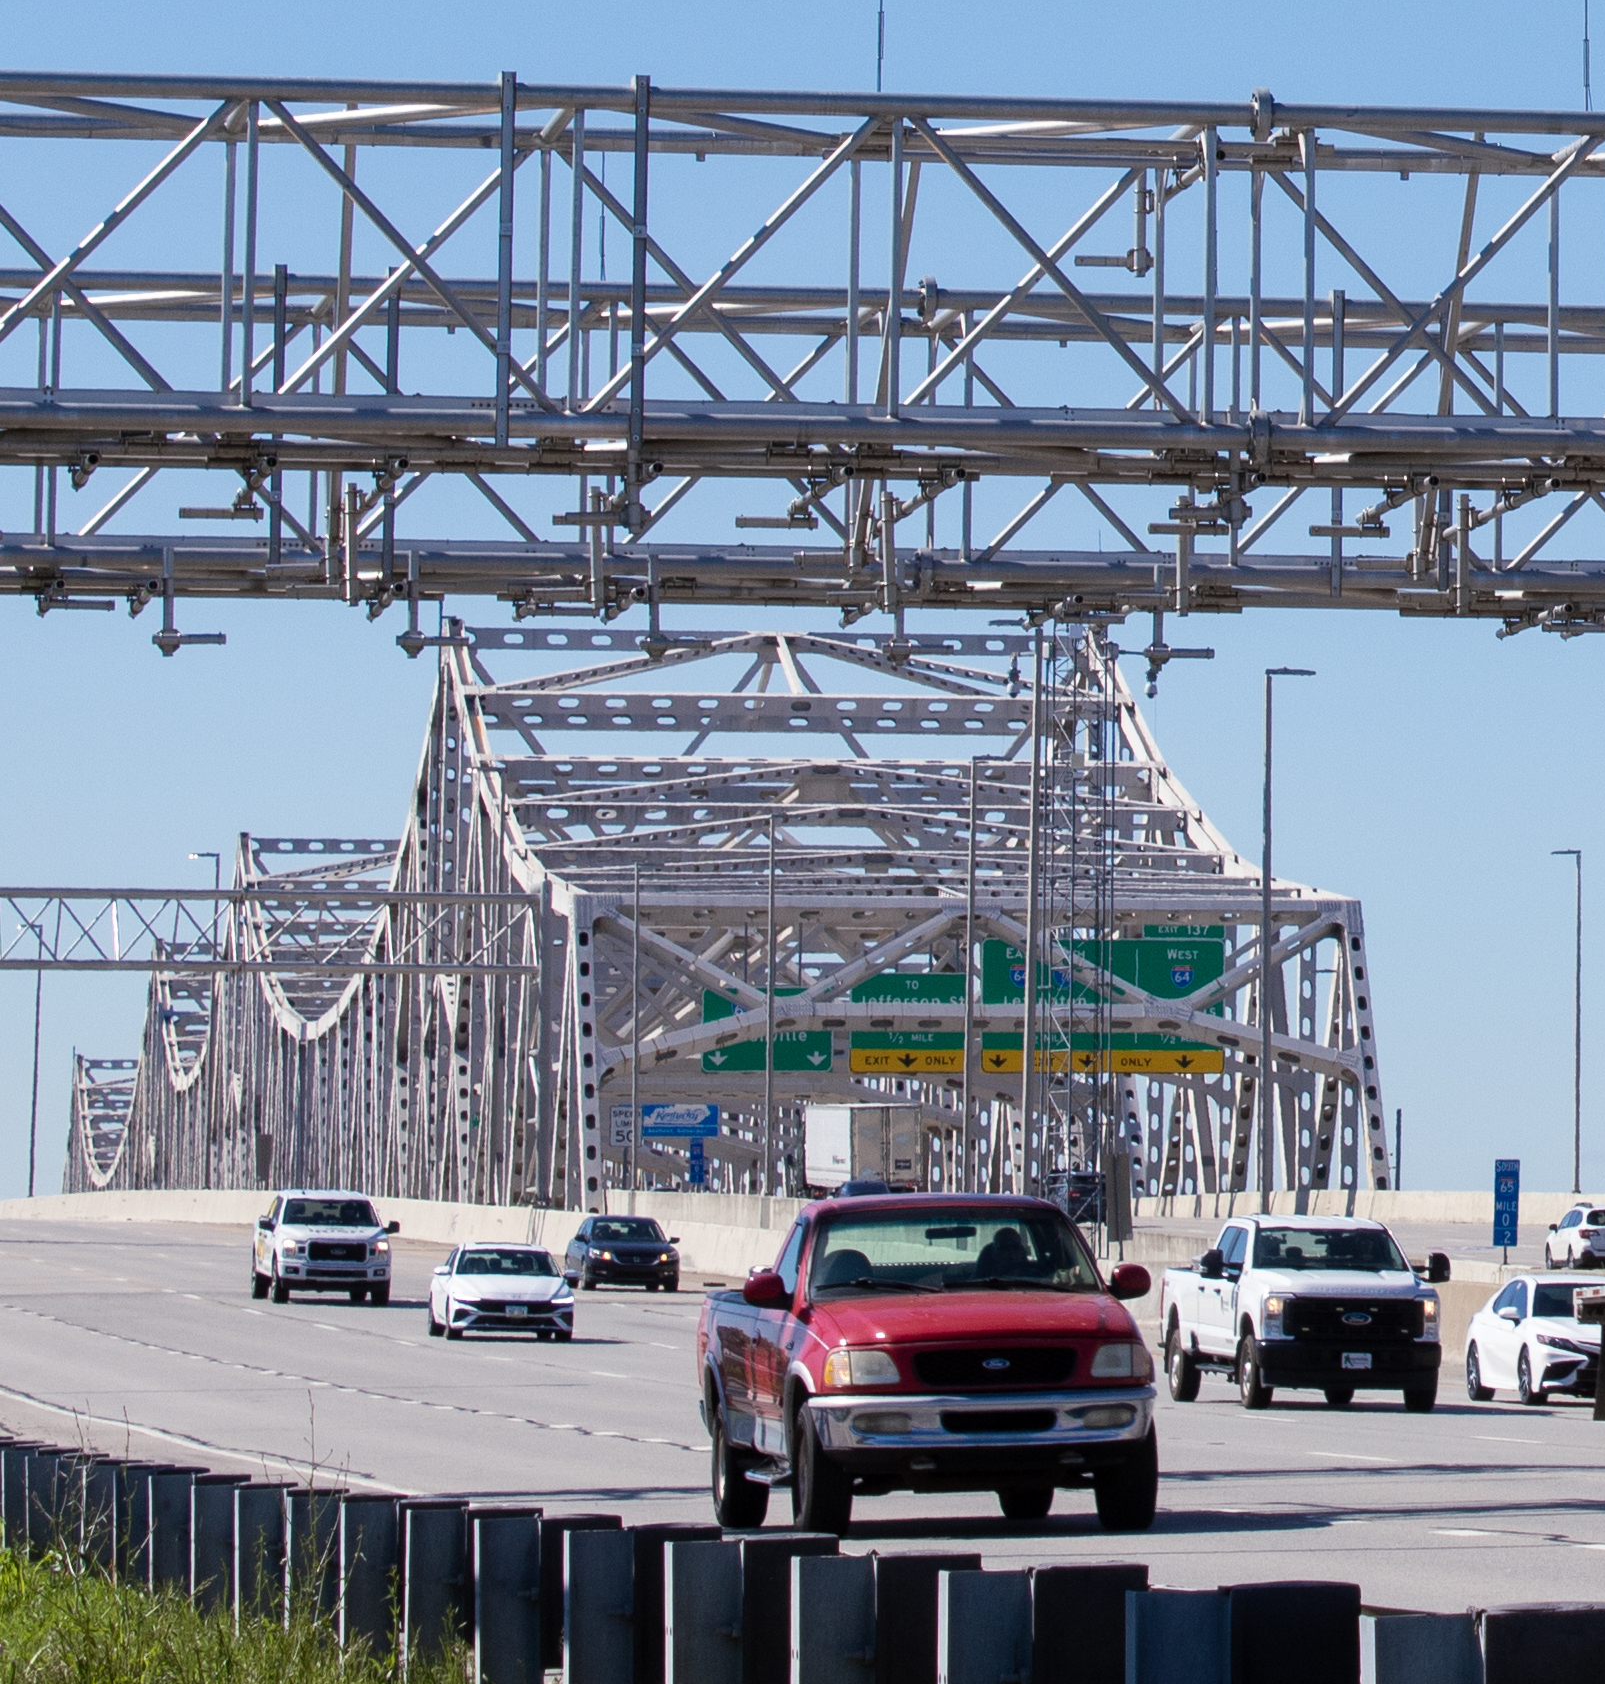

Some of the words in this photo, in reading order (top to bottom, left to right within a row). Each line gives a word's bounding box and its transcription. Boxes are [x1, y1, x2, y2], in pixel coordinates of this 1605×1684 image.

[1158, 925, 1179, 934] EXIT
[1187, 925, 1209, 936] 137
[1167, 949, 1199, 959] WEST
[1174, 972, 1190, 983] 64
[905, 980, 919, 990] TO
[911, 1034, 933, 1042] MILE
[864, 1056, 889, 1065] EXIT
[925, 1056, 956, 1065] ONLY
[1120, 1057, 1152, 1067] ONLY
[1500, 1181, 1514, 1192] 65
[1496, 1201, 1516, 1211] MILE
[1502, 1213, 1510, 1226] 0
